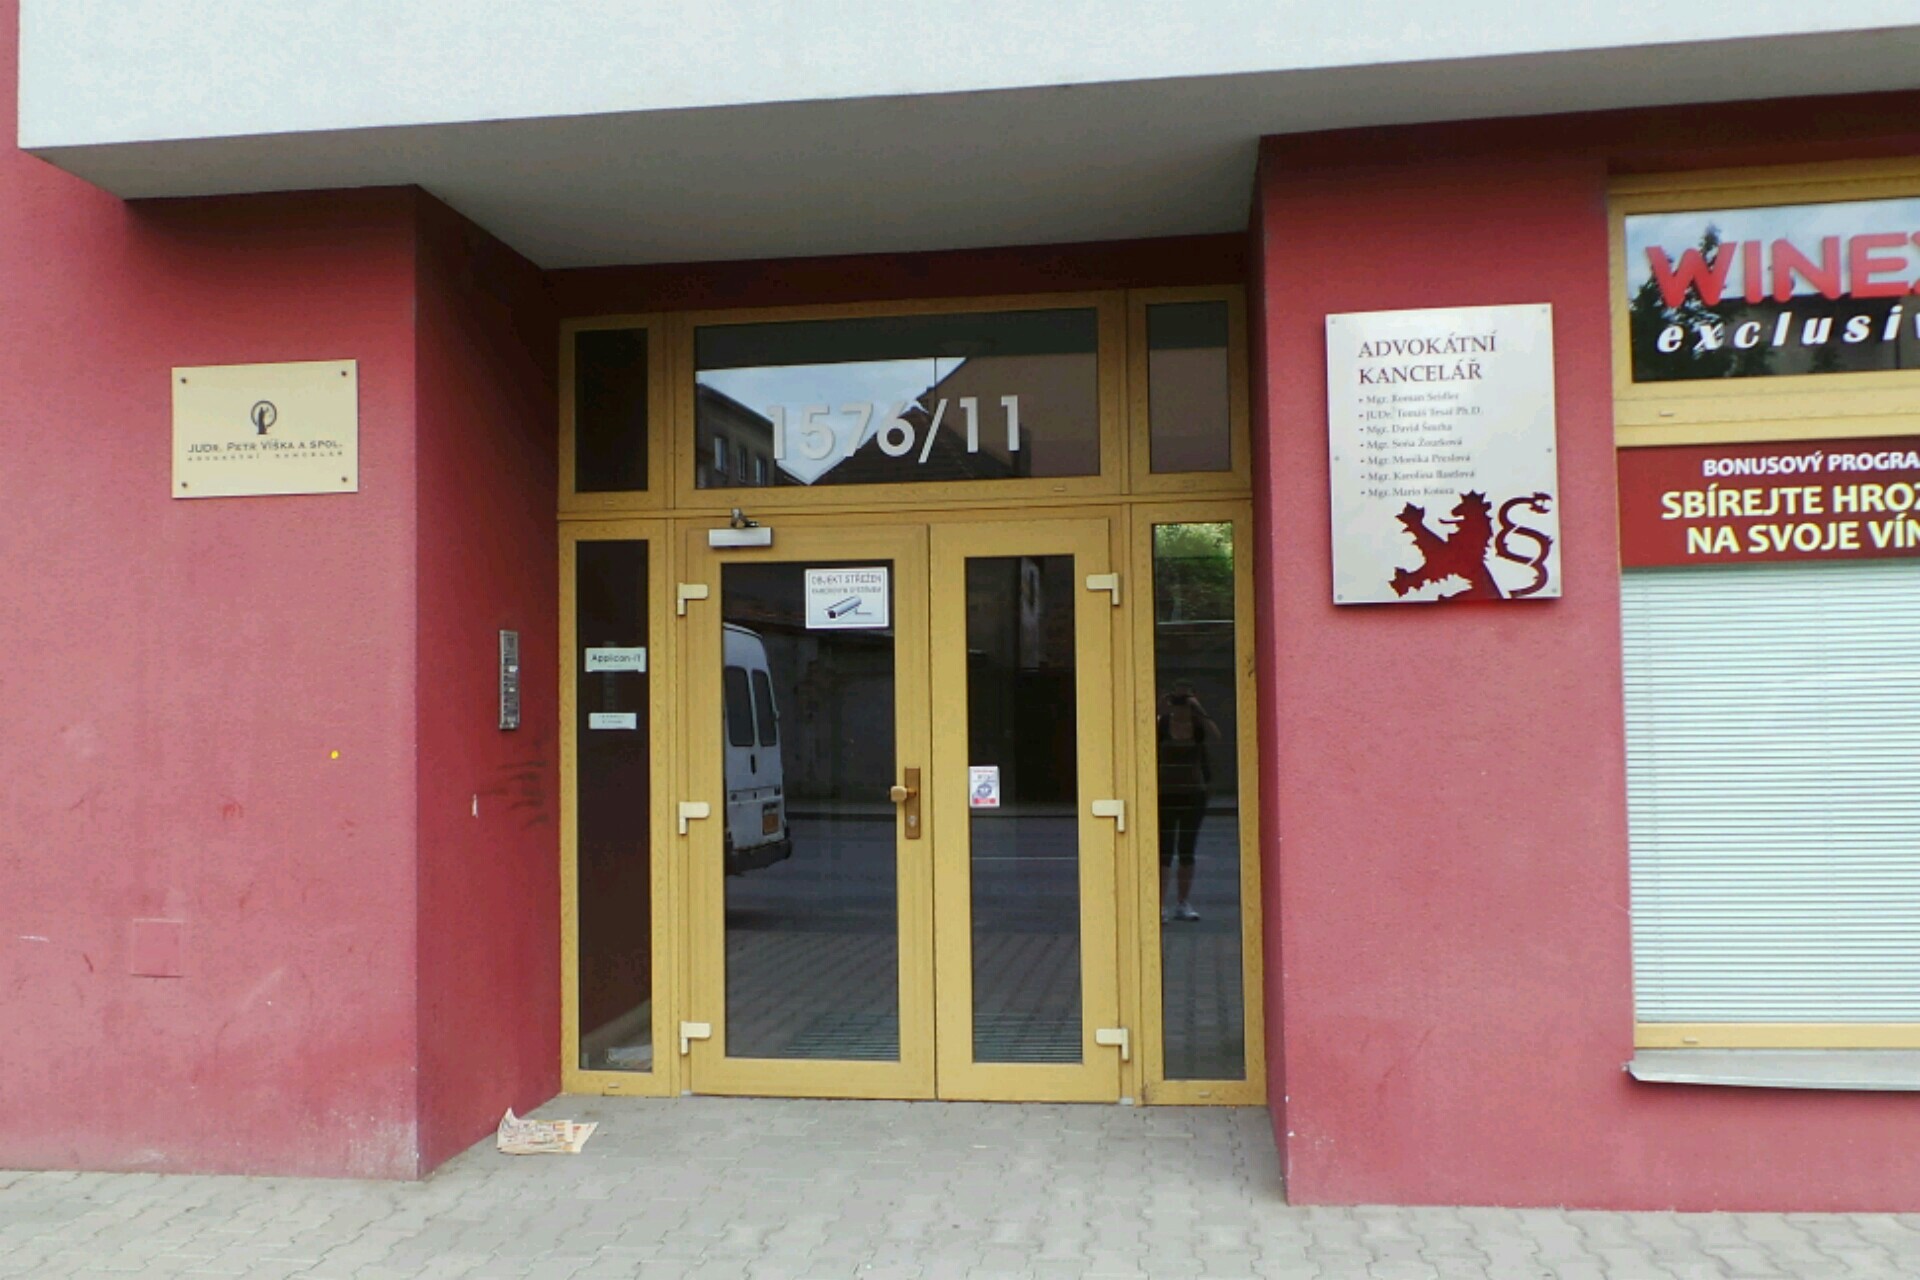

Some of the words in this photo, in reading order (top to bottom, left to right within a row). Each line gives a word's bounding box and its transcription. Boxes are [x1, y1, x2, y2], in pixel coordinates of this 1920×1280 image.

[1645, 231, 1920, 308] WINE
[1657, 305, 1920, 353] exclusi
[1358, 330, 1498, 358] ADVOKÁTNÍ
[1358, 360, 1483, 385] KANCELÁŘ
[1366, 395, 1389, 405] Mgr.
[767, 395, 1020, 463] 1576/11
[1366, 425, 1389, 435] Mgr.
[1391, 423, 1419, 433] David
[1366, 440, 1389, 450] Mgr.
[1367, 455, 1390, 466] Mgr.
[1392, 453, 1429, 464] Monika
[1703, 451, 1823, 477] BONUSOVÝ
[1367, 471, 1391, 482] Mgr.
[1367, 486, 1390, 497] Mgr.
[1392, 485, 1421, 496] Mario
[1661, 483, 1824, 519] SBÍREJTE
[1687, 526, 1740, 554] NA
[1748, 520, 1861, 553] SVOJE
